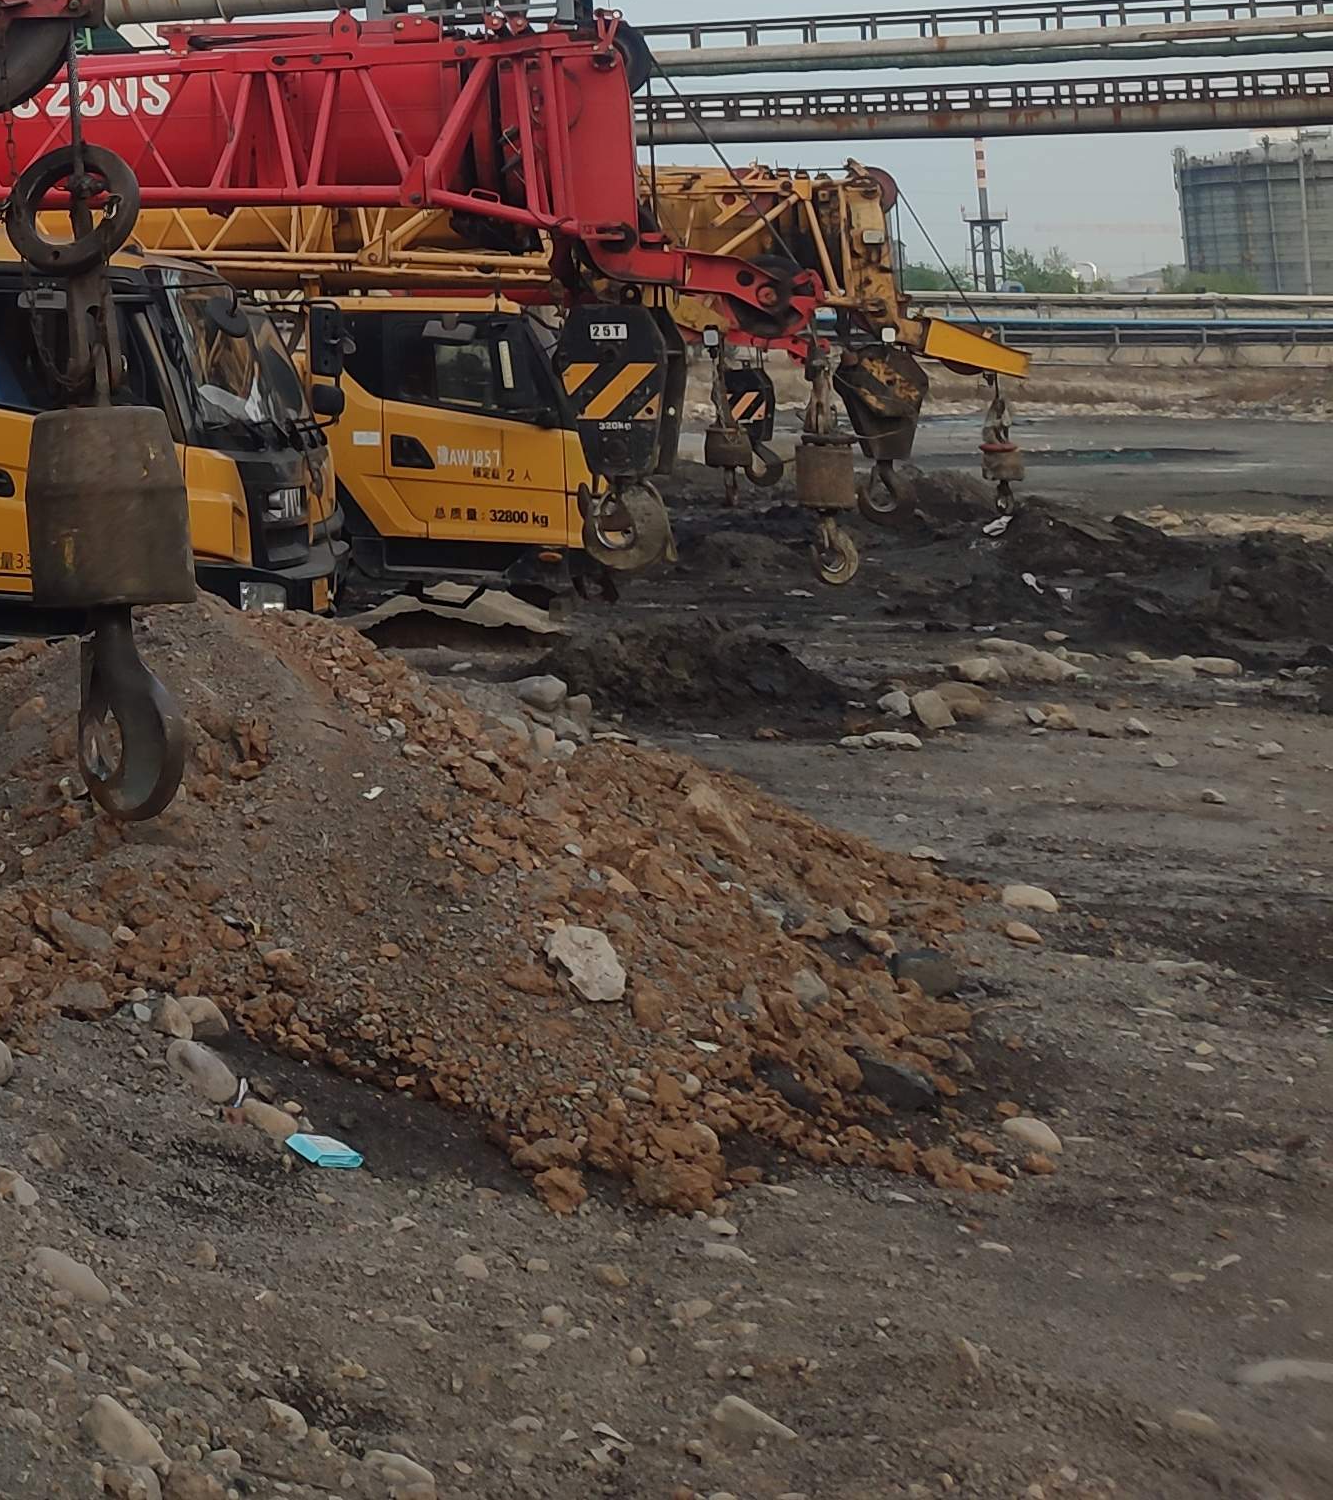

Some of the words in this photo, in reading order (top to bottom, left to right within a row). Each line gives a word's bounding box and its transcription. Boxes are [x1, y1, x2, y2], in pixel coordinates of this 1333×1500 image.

[592, 325, 621, 337] 25T
[507, 468, 515, 482] 2
[523, 469, 532, 482] 人
[489, 508, 529, 524] 32800
[532, 511, 549, 528] kg
